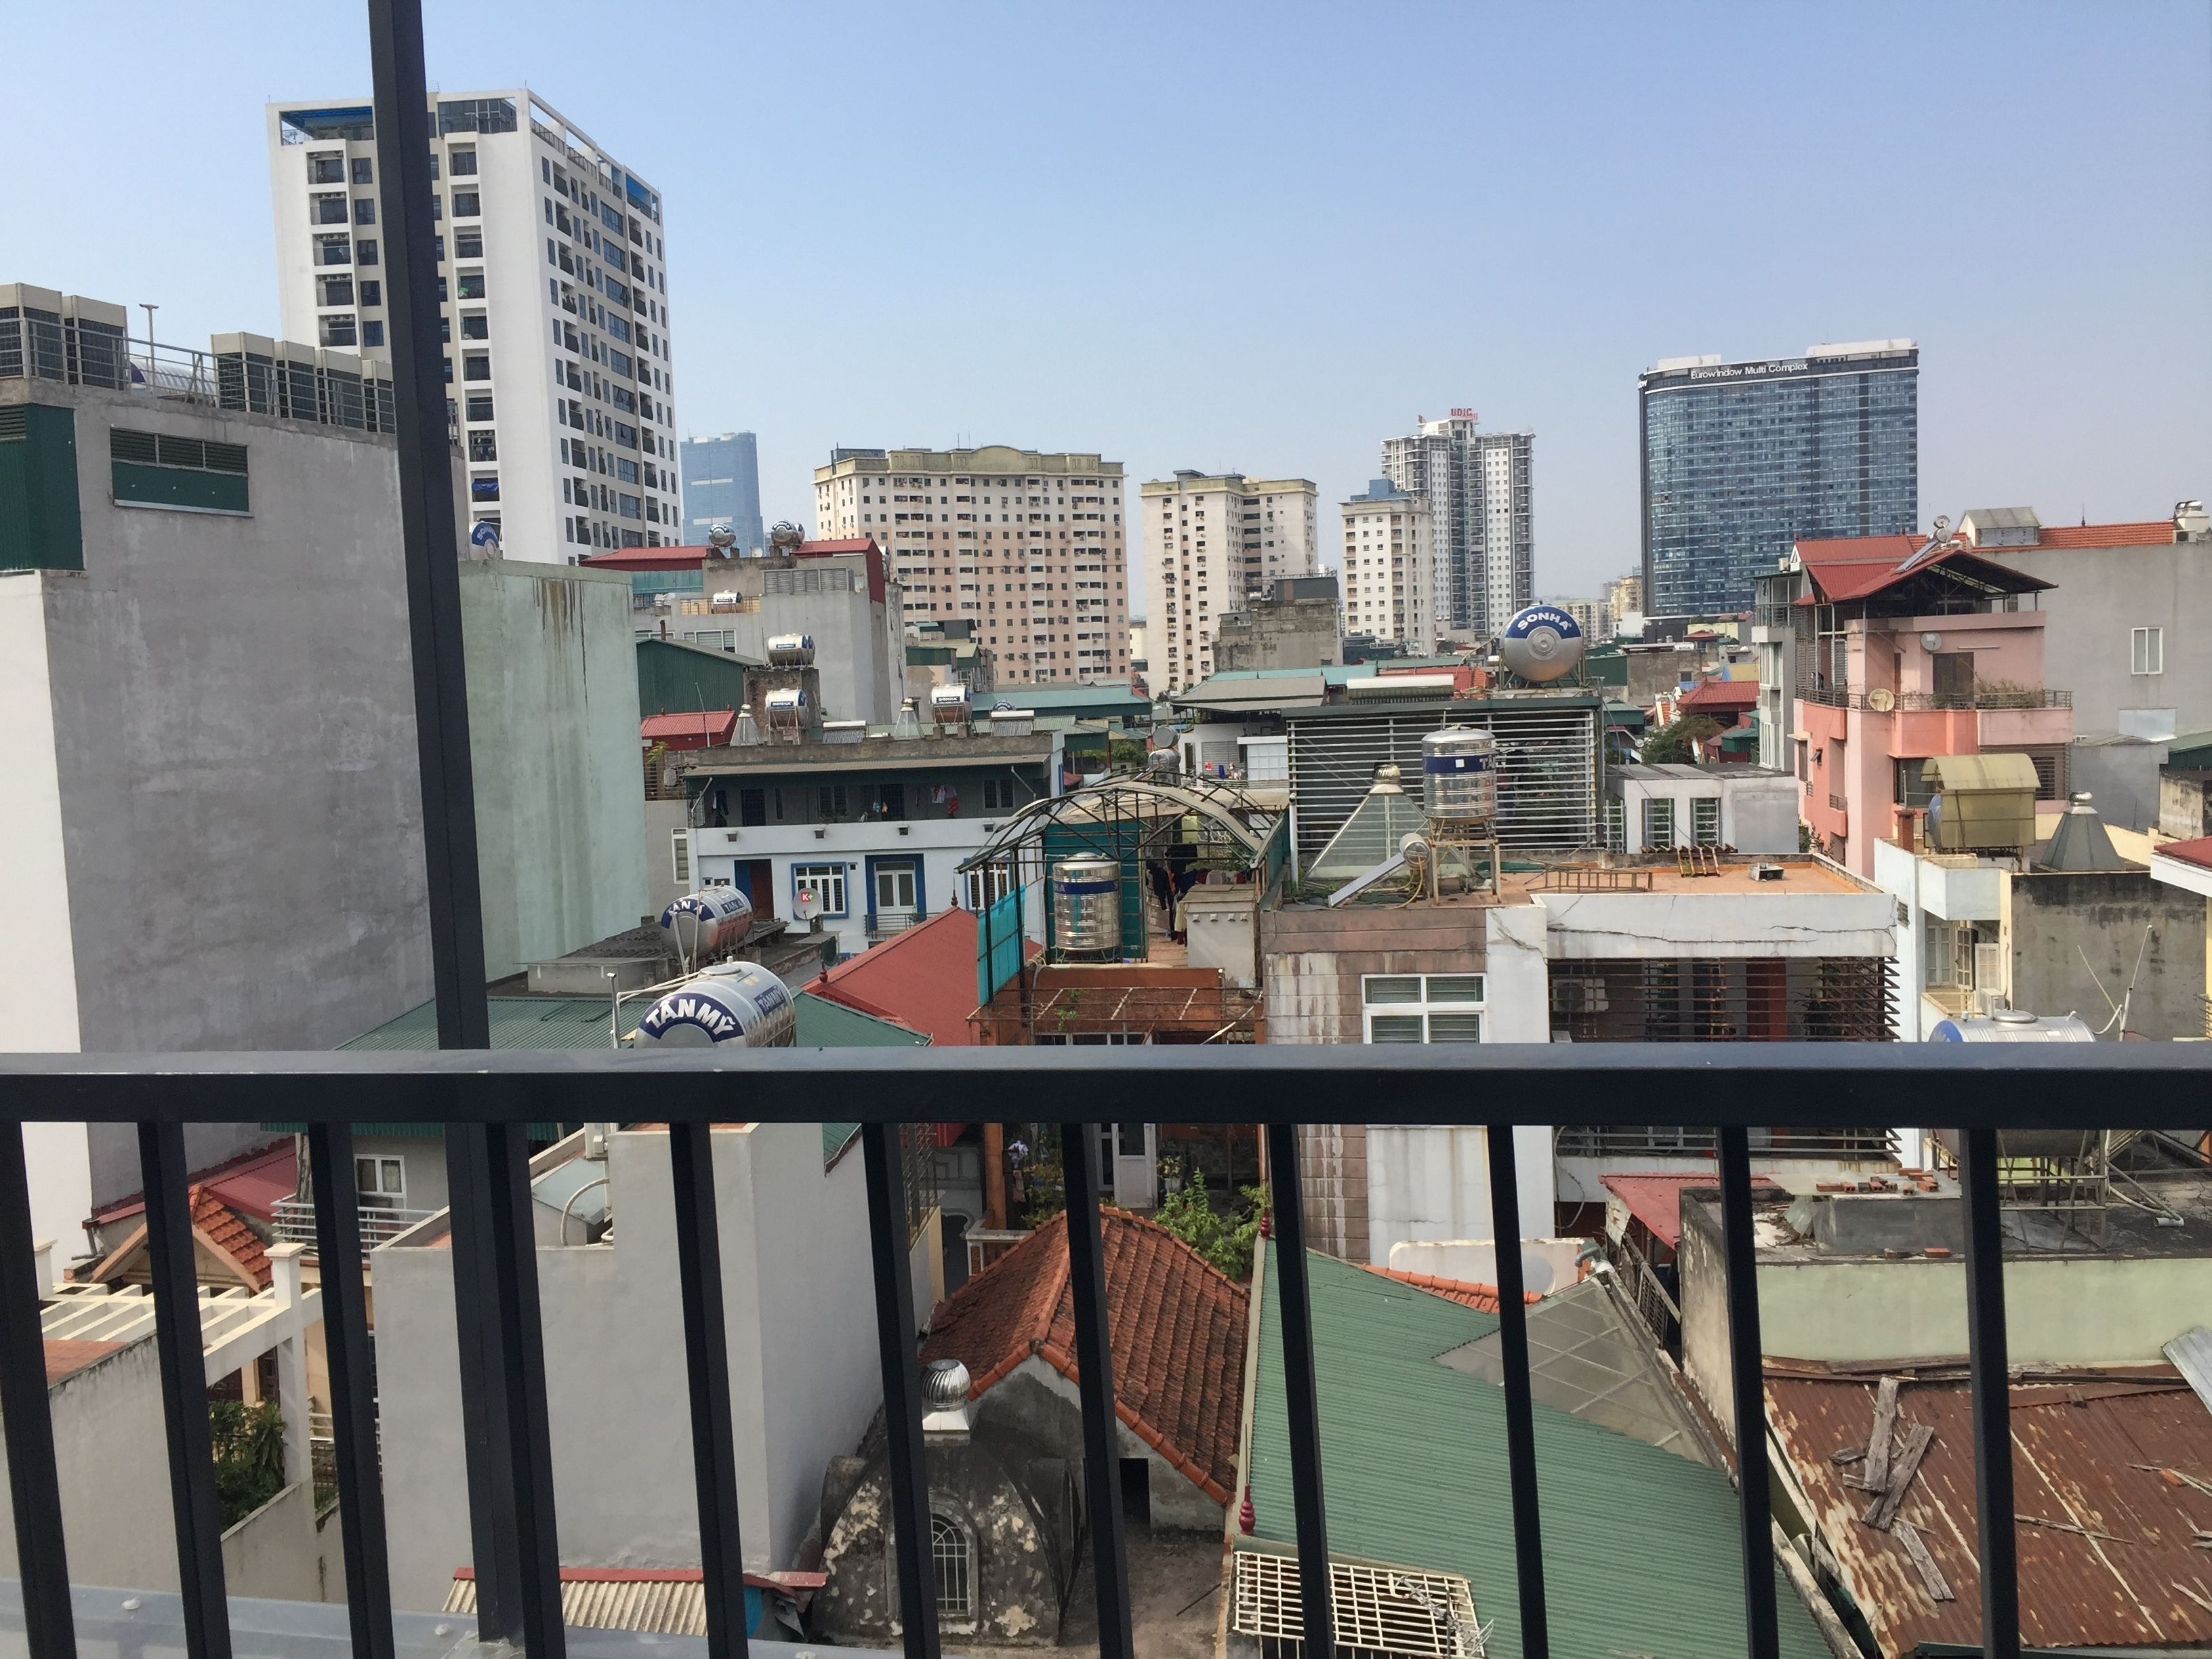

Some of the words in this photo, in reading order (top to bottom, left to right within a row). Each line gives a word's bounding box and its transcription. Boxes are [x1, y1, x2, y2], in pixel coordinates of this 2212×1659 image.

[1691, 368, 1742, 380] Eurowindow
[1745, 365, 1766, 375] Multi
[1769, 363, 1808, 373] Complex
[1451, 408, 1472, 416] UDIC
[1517, 613, 1568, 630] SONHA
